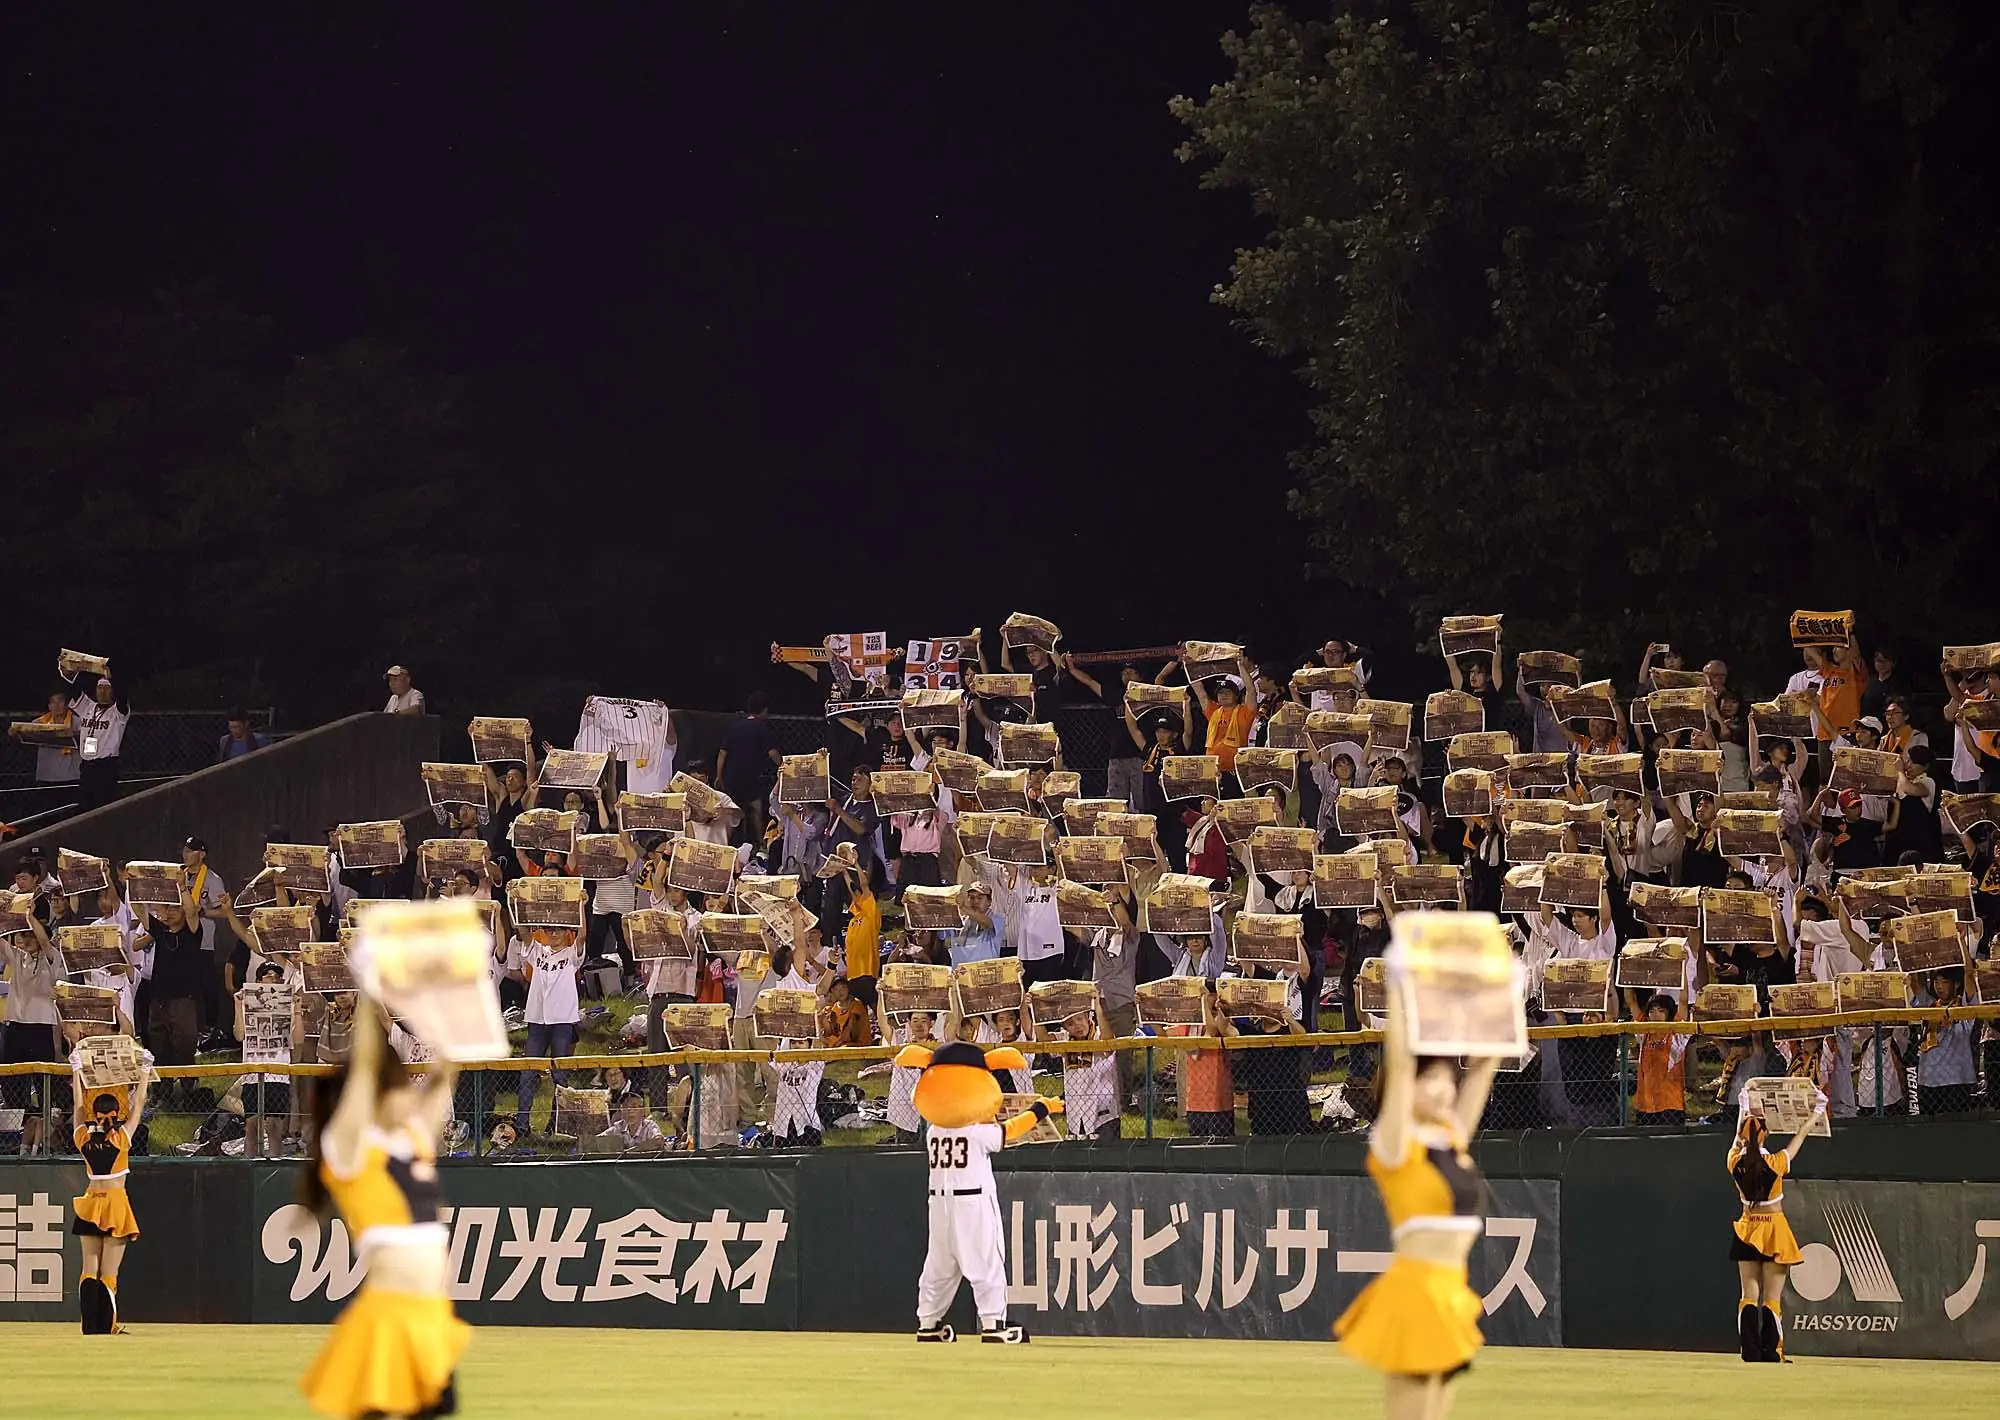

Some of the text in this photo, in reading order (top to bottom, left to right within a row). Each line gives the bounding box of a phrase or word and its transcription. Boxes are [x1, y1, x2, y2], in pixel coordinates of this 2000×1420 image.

[623, 706, 638, 719] 3
[1906, 1066, 1919, 1088] ERA
[930, 1137, 968, 1169] 333
[1008, 1200, 1547, 1318] 山形ビルサース
[1793, 1315, 1898, 1332] HASSYOEN
